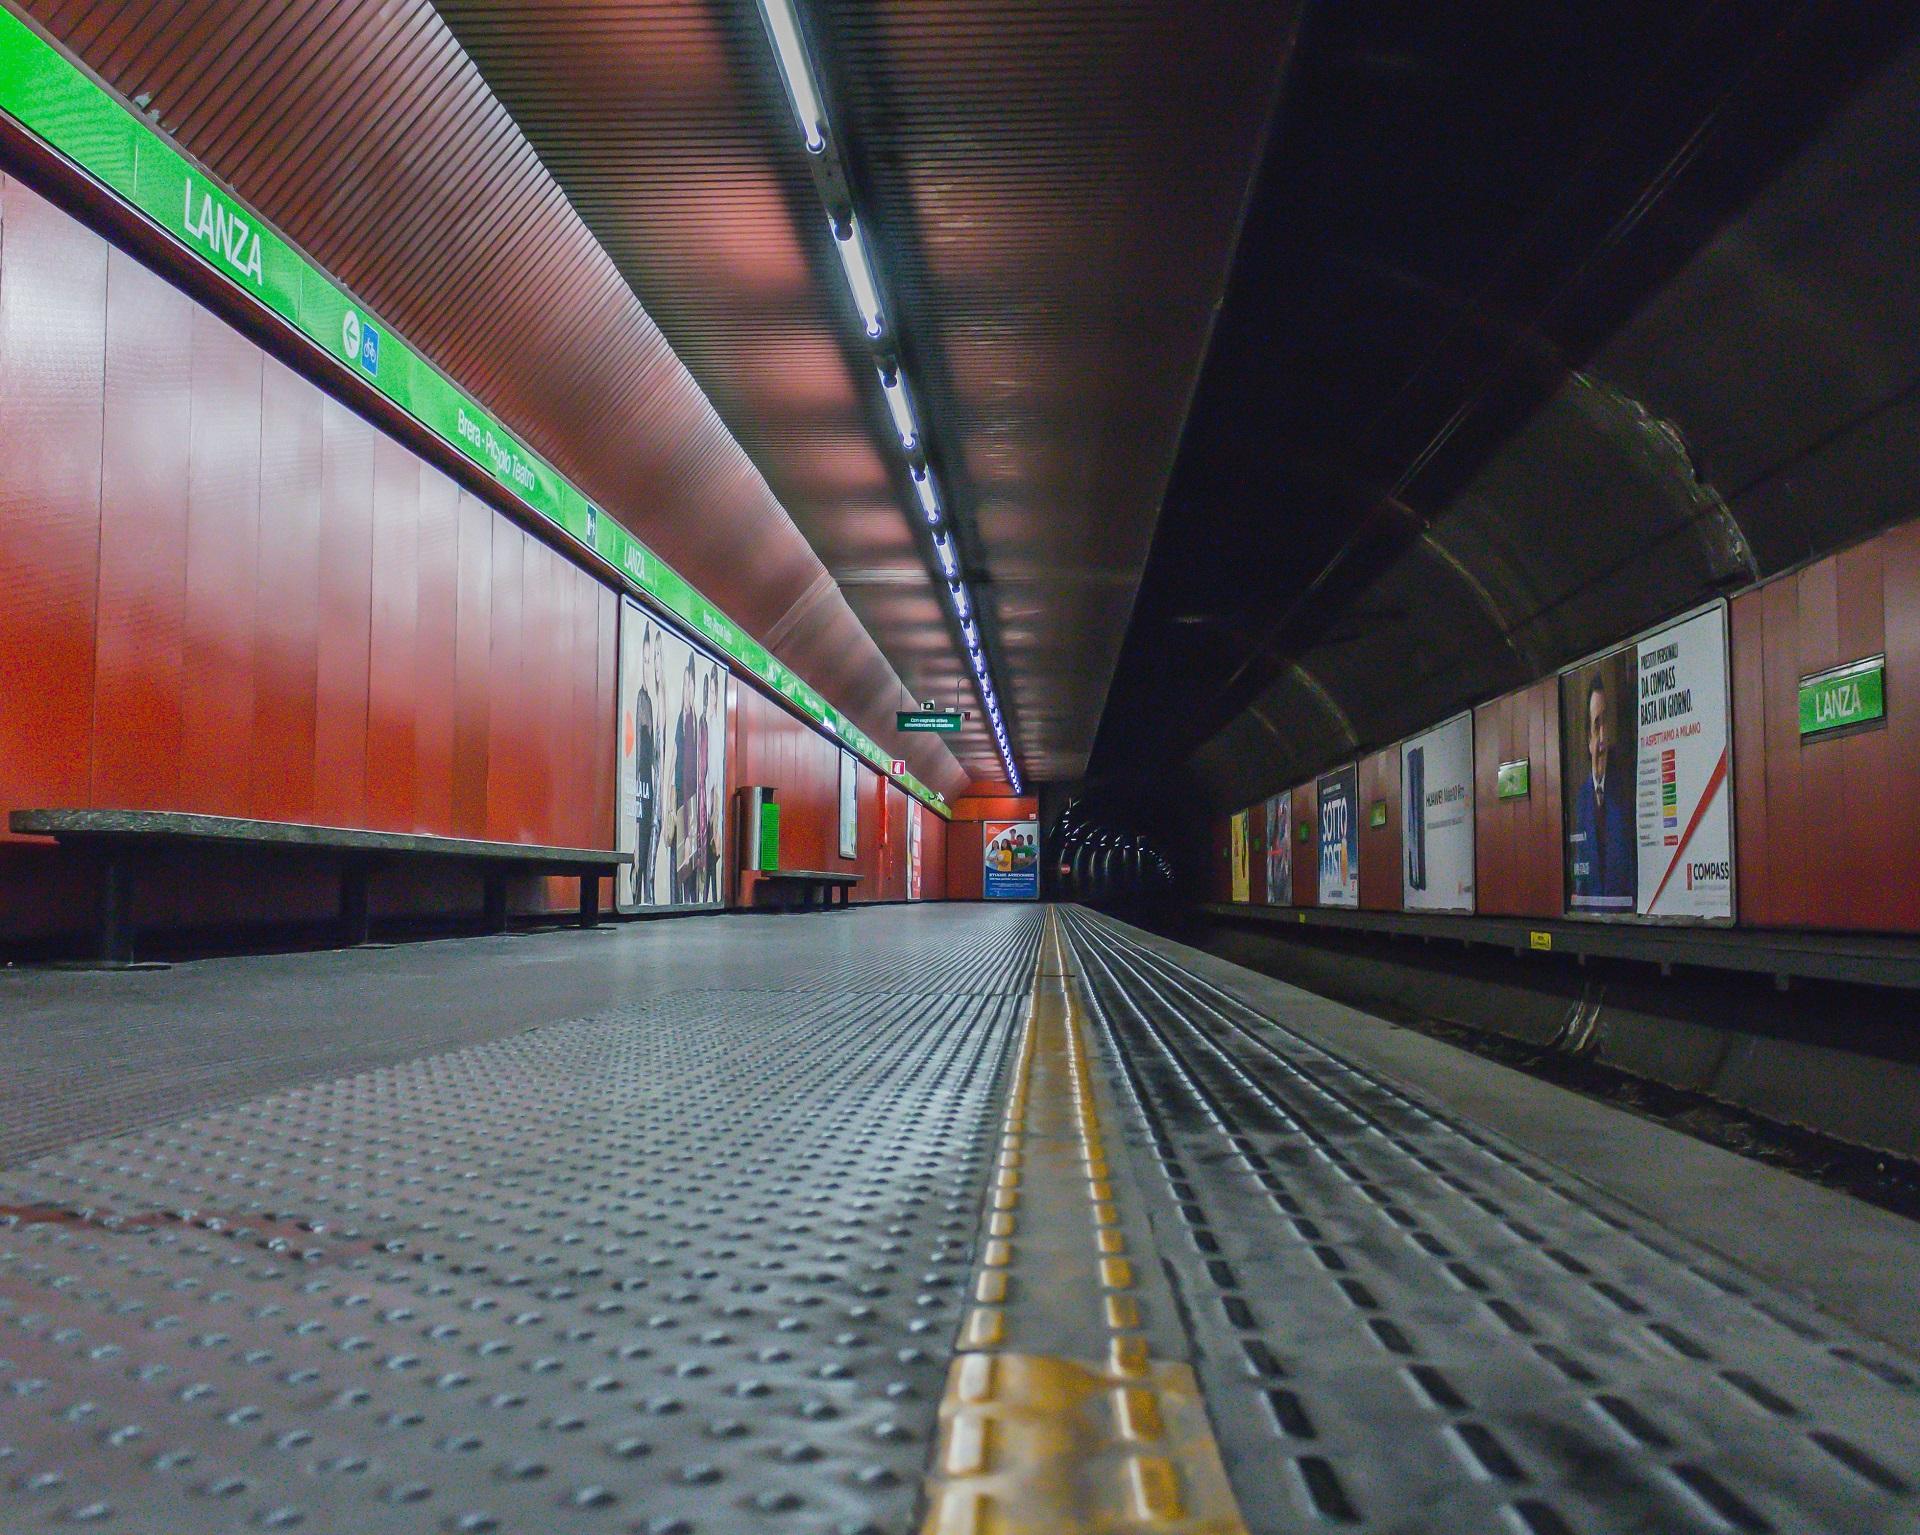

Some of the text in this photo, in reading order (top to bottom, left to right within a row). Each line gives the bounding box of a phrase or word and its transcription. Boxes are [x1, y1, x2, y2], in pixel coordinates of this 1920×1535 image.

[184, 177, 263, 287] LANZA
[458, 407, 481, 448] Brera
[512, 453, 535, 491] Teatro
[624, 540, 645, 580] LANZA
[1641, 665, 1676, 699] DA COMPASS
[1640, 700, 1658, 726] BASTA
[1658, 697, 1667, 721] UN
[1815, 683, 1862, 723] LANZA
[1680, 721, 1701, 737] MILANO
[1322, 796, 1348, 842] SOTTO
[1693, 861, 1729, 881] COMPASS
